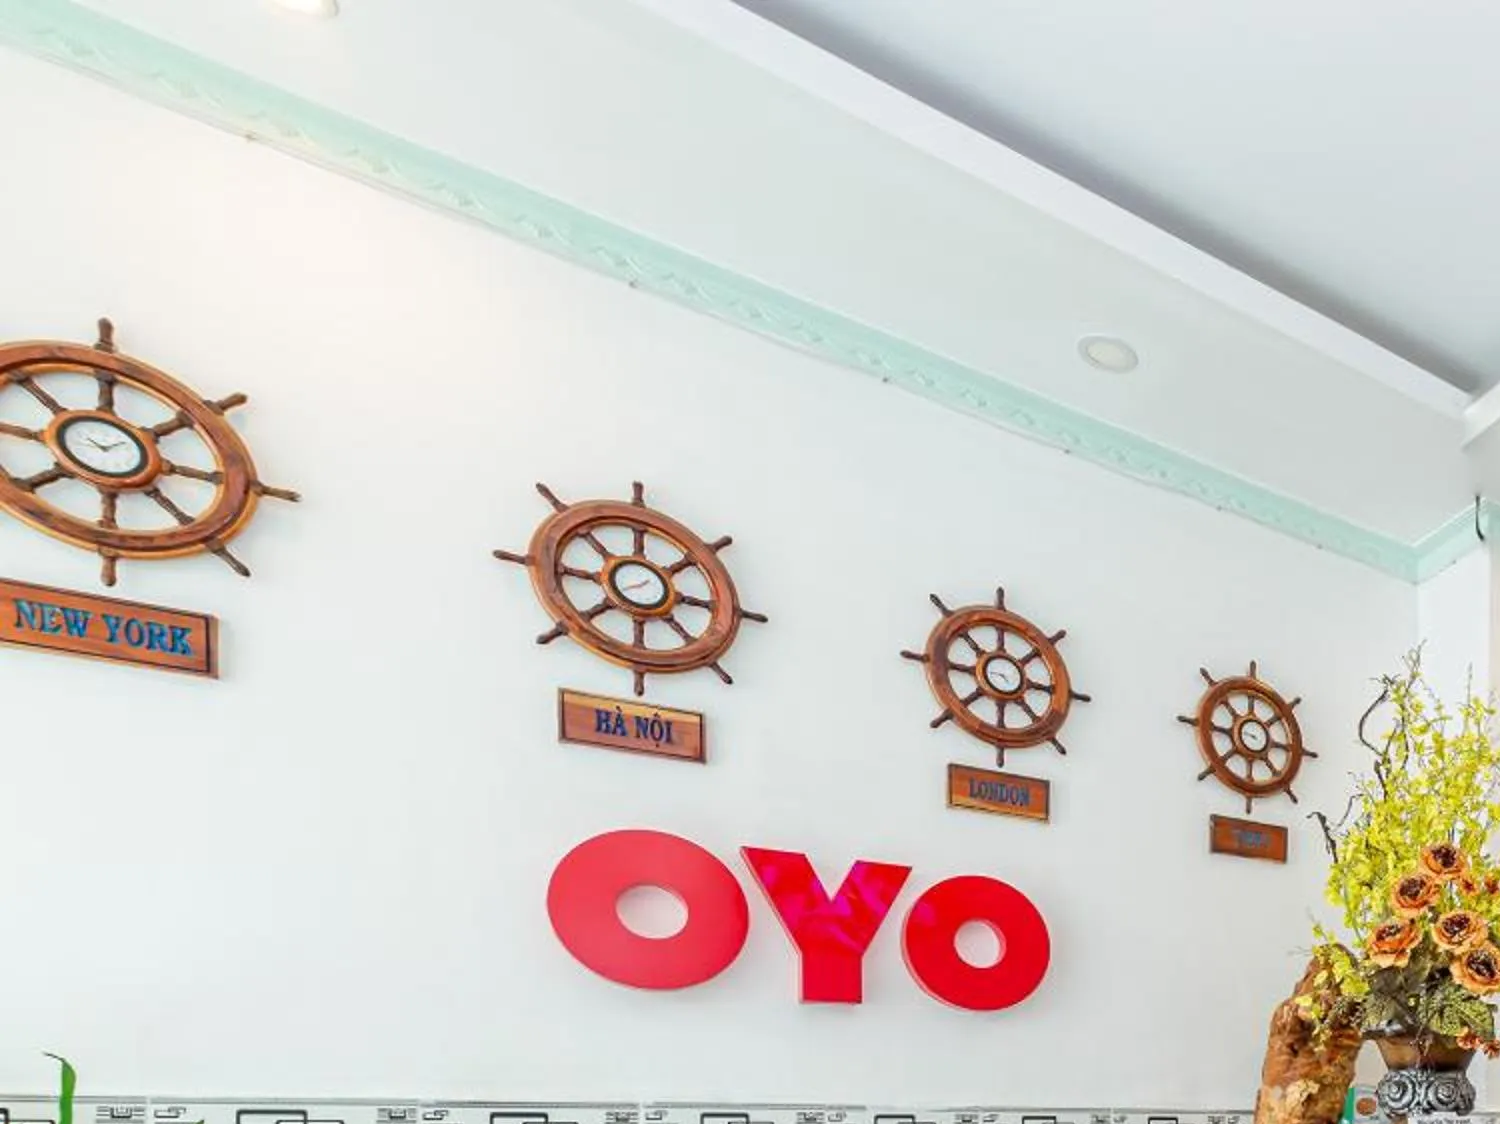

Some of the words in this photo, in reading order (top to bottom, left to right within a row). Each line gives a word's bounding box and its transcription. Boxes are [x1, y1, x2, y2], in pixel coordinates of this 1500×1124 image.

[13, 597, 94, 639] NEW
[102, 613, 194, 656] YORK
[595, 705, 628, 737] HÀ
[633, 711, 675, 748] NỘI
[968, 776, 1031, 807] LONDON
[546, 828, 1052, 1012] OYO
